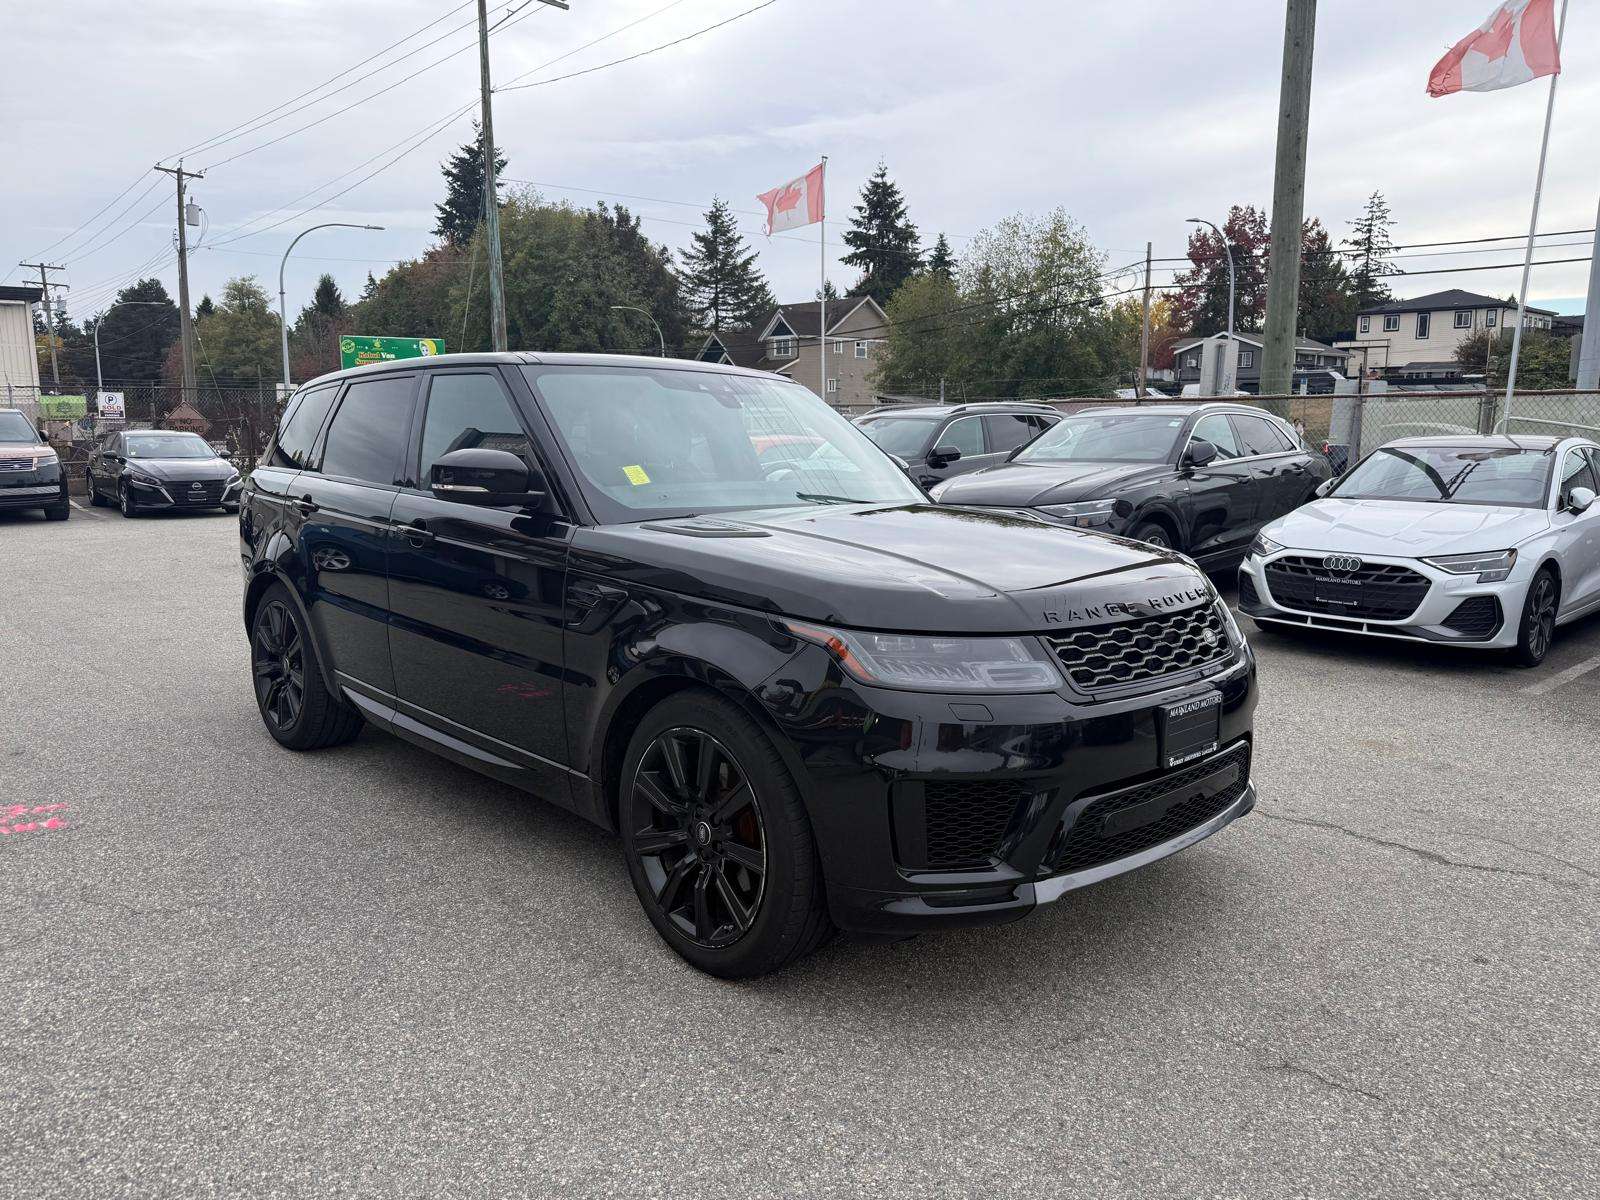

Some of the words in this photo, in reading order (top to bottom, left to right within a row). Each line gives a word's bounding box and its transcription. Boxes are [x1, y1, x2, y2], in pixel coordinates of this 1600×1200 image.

[169, 425, 204, 433] PARKING
[1043, 602, 1139, 624] RANGE
[1148, 587, 1207, 610] ROVER
[1169, 701, 1200, 717] MAINLAND
[1200, 695, 1222, 709] MOTORS
